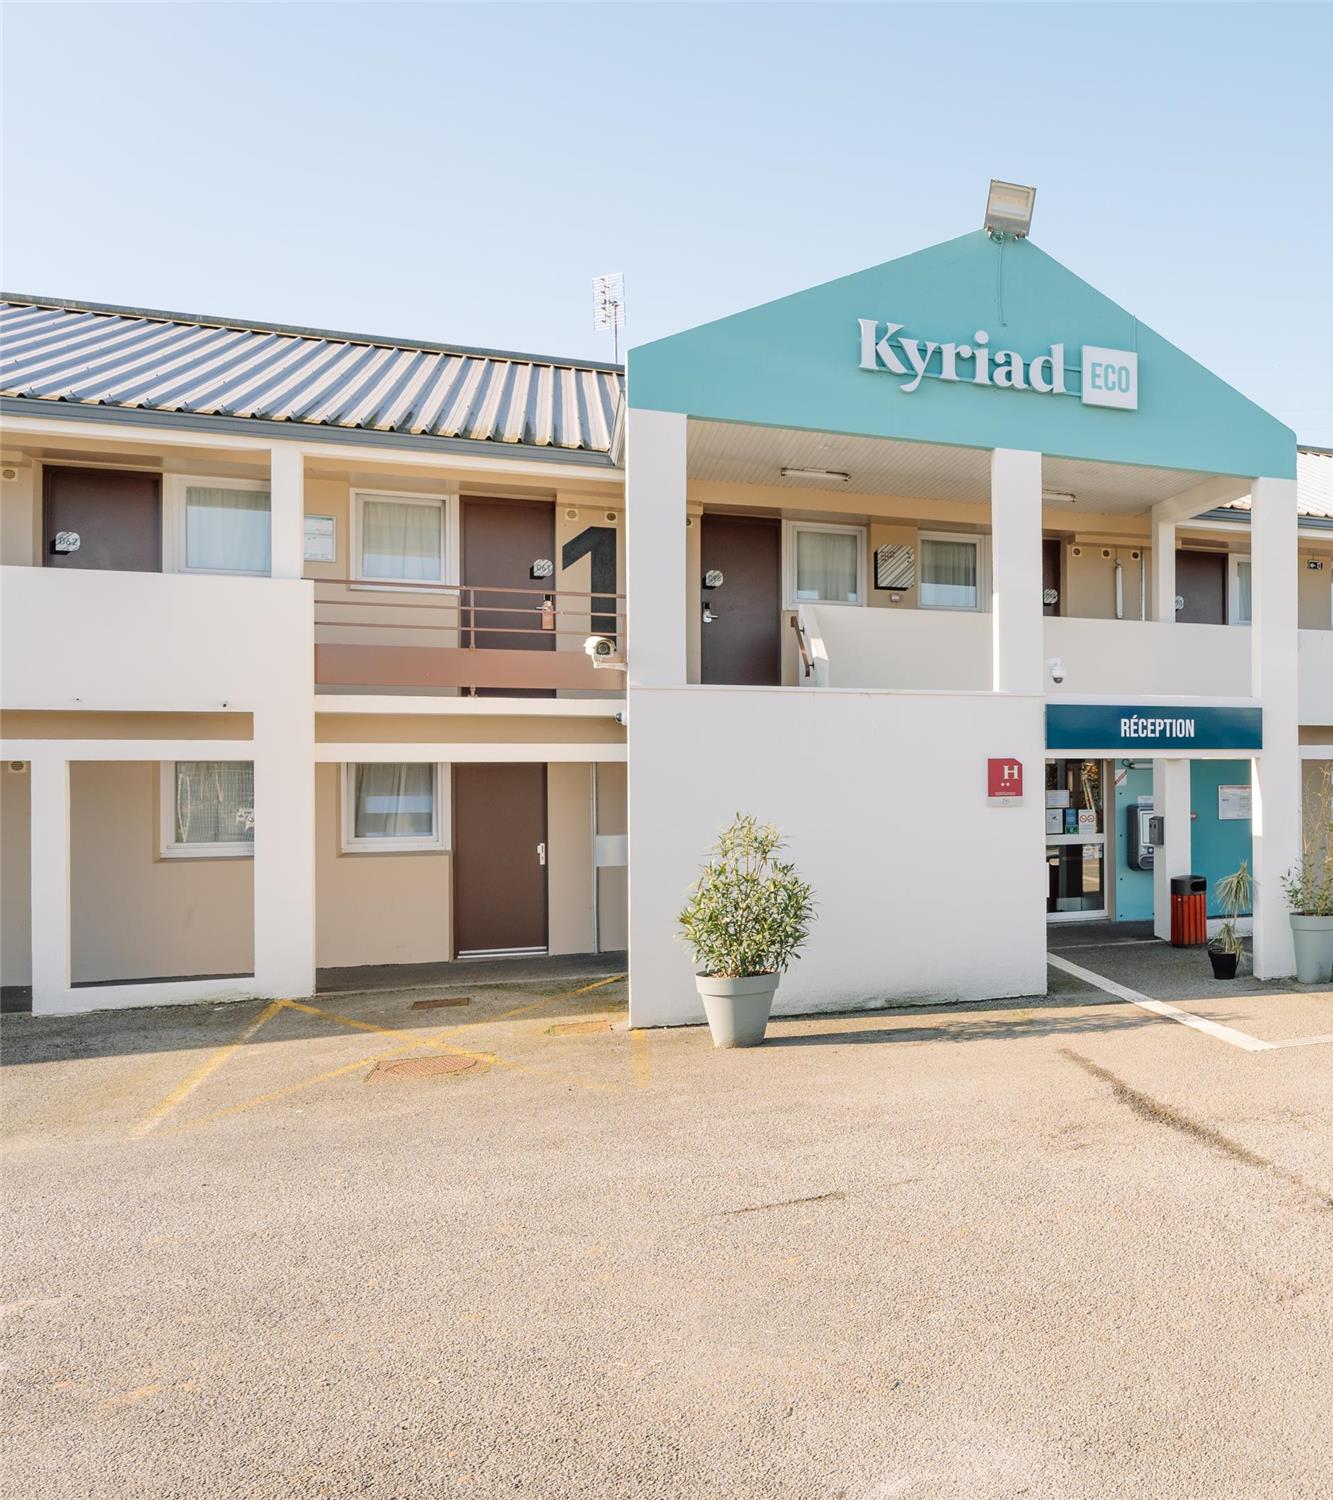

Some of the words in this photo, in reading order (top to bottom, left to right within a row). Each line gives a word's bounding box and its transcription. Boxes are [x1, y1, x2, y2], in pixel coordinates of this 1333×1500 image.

[858, 318, 1067, 393] Kyriad
[1090, 362, 1131, 394] ECO
[562, 526, 617, 651] 1
[1120, 714, 1195, 738] RÉCEPTION
[1003, 765, 1019, 780] H
